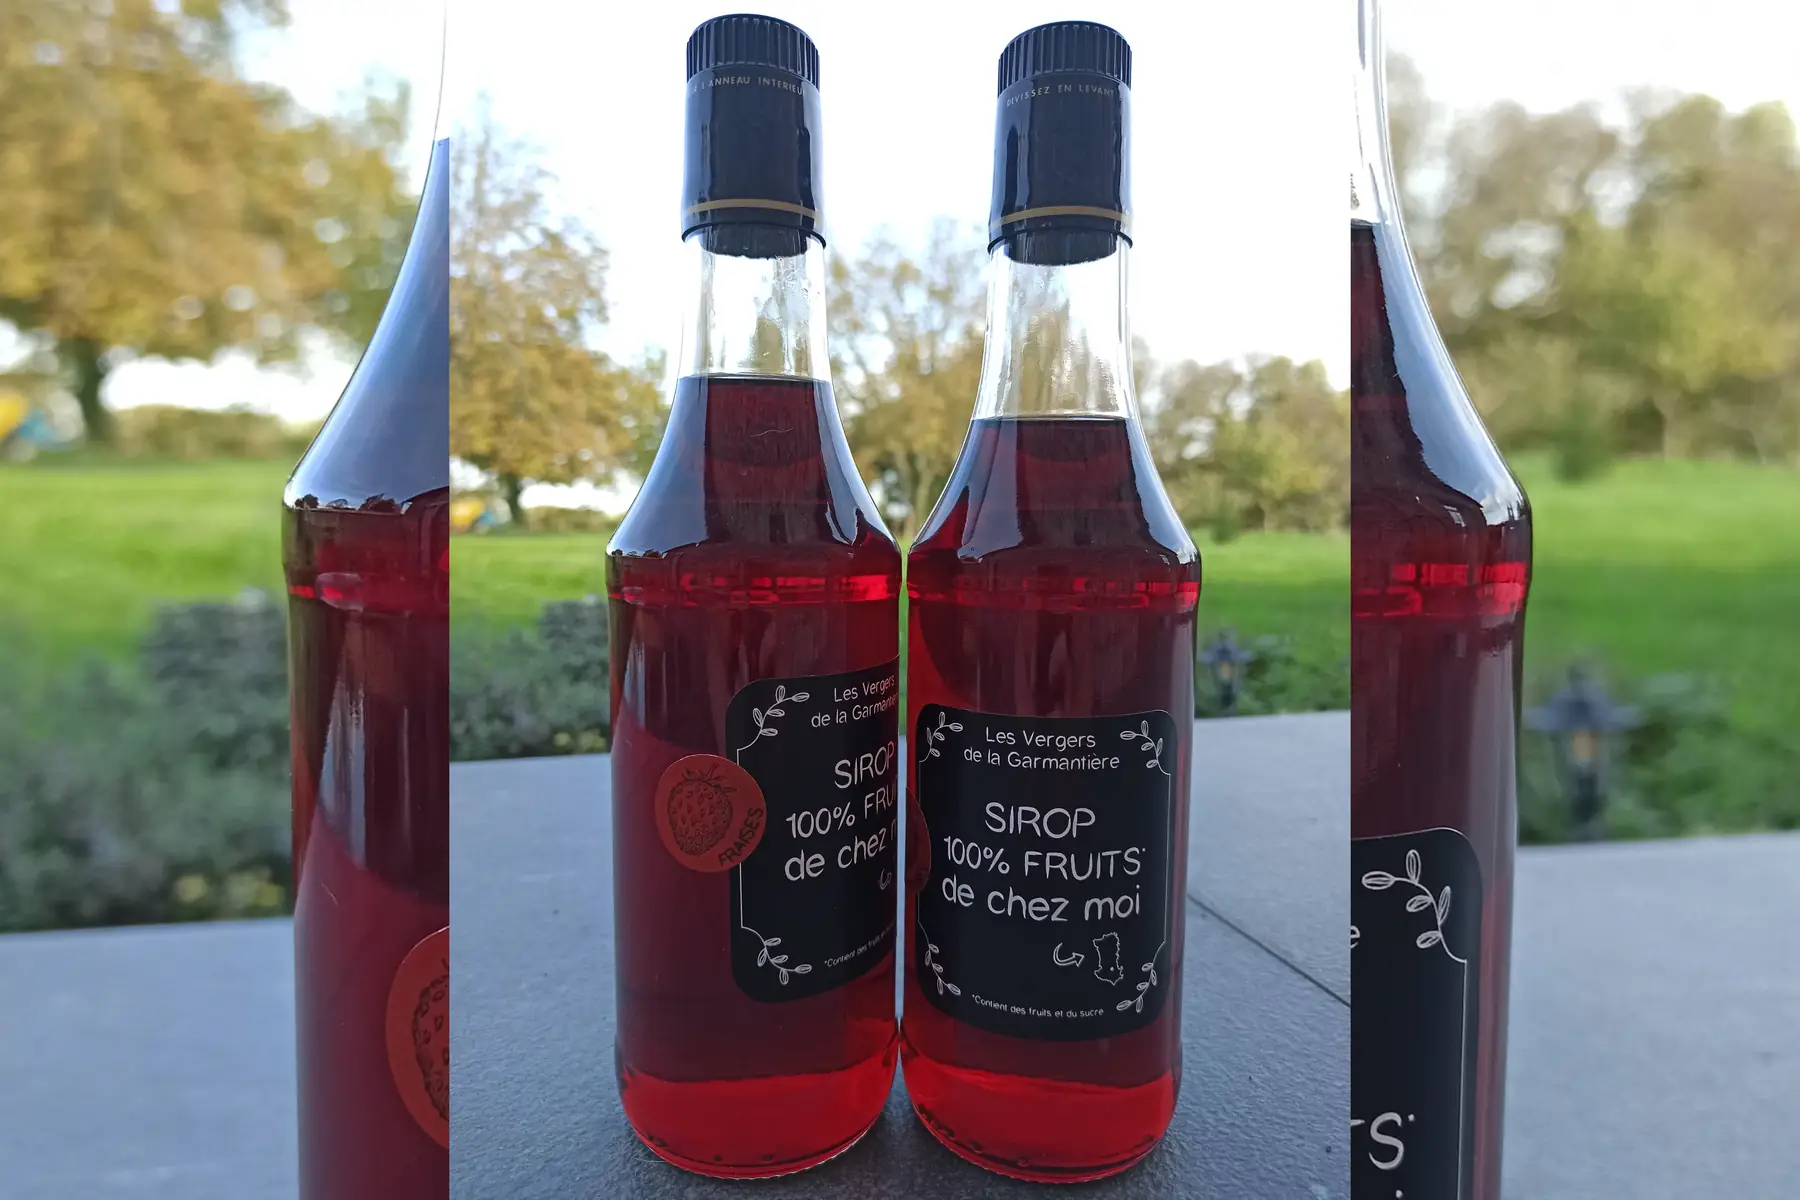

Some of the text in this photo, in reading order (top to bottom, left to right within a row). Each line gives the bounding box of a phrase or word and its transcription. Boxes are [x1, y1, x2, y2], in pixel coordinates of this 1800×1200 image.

[758, 76, 804, 96] INTERIEU
[1058, 84, 1073, 94] EN
[833, 675, 895, 703] Les Vergers
[811, 712, 831, 728] de
[835, 708, 848, 724] la
[985, 727, 1097, 752] Les Vergers
[834, 740, 895, 789] SIROP
[963, 747, 1121, 770] de la Garmantière
[785, 801, 856, 839] 100%
[984, 801, 1097, 839] SIROP
[717, 807, 764, 867] FRAISES
[784, 848, 826, 881] de
[837, 827, 887, 869] chez
[943, 836, 1010, 875] 100%
[941, 874, 975, 907] de
[987, 887, 1068, 922] chez
[1084, 884, 1140, 922] moi
[1010, 1005, 1026, 1015] des
[1028, 1006, 1052, 1018] fruits
[1054, 1009, 1063, 1018] et
[1066, 1009, 1077, 1018] du
[1079, 1008, 1104, 1018] sucre
